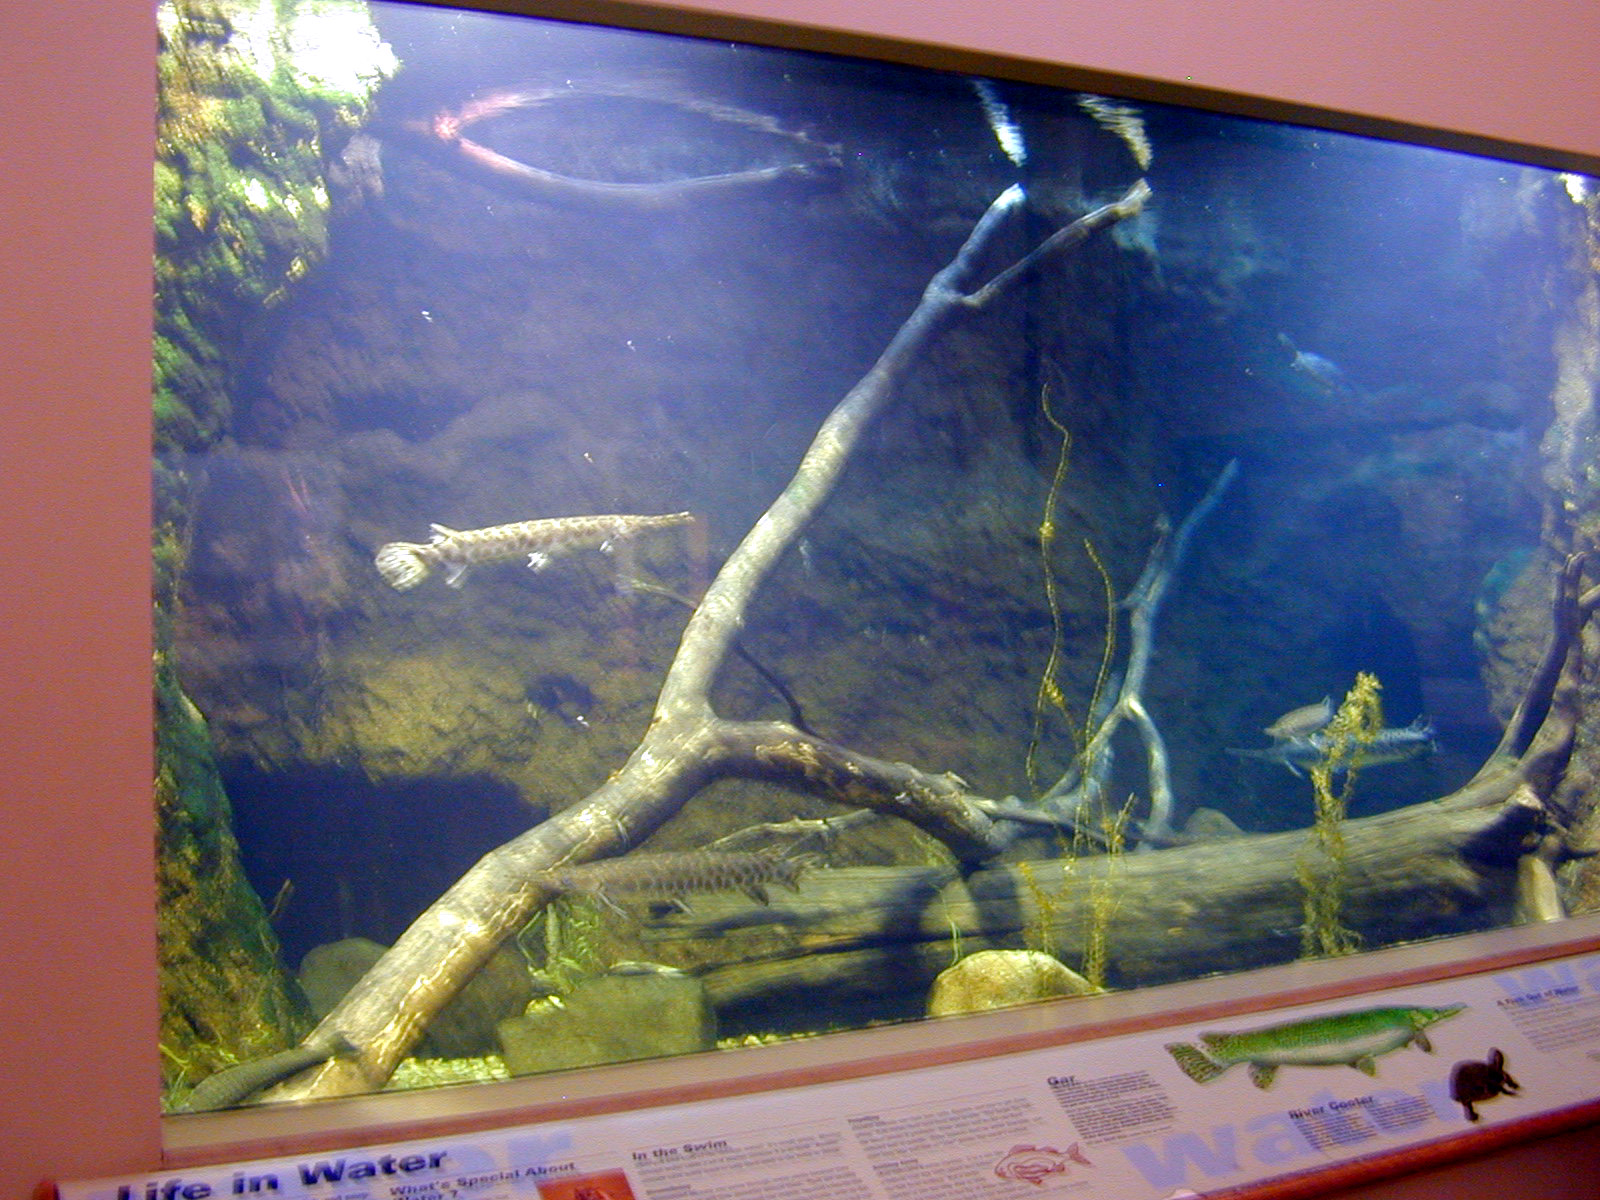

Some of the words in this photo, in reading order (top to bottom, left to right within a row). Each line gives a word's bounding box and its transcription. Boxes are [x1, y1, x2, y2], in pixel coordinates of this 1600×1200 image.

[1288, 1105, 1325, 1119] River
[632, 1151, 647, 1160] In
[652, 1147, 678, 1157] the
[682, 1140, 728, 1152] Swim
[117, 1177, 212, 1200] Life
[233, 1171, 279, 1194] in
[298, 1151, 448, 1185] Water
[390, 1180, 450, 1195] What's
[457, 1169, 520, 1187] Special
[525, 1162, 576, 1177] About
